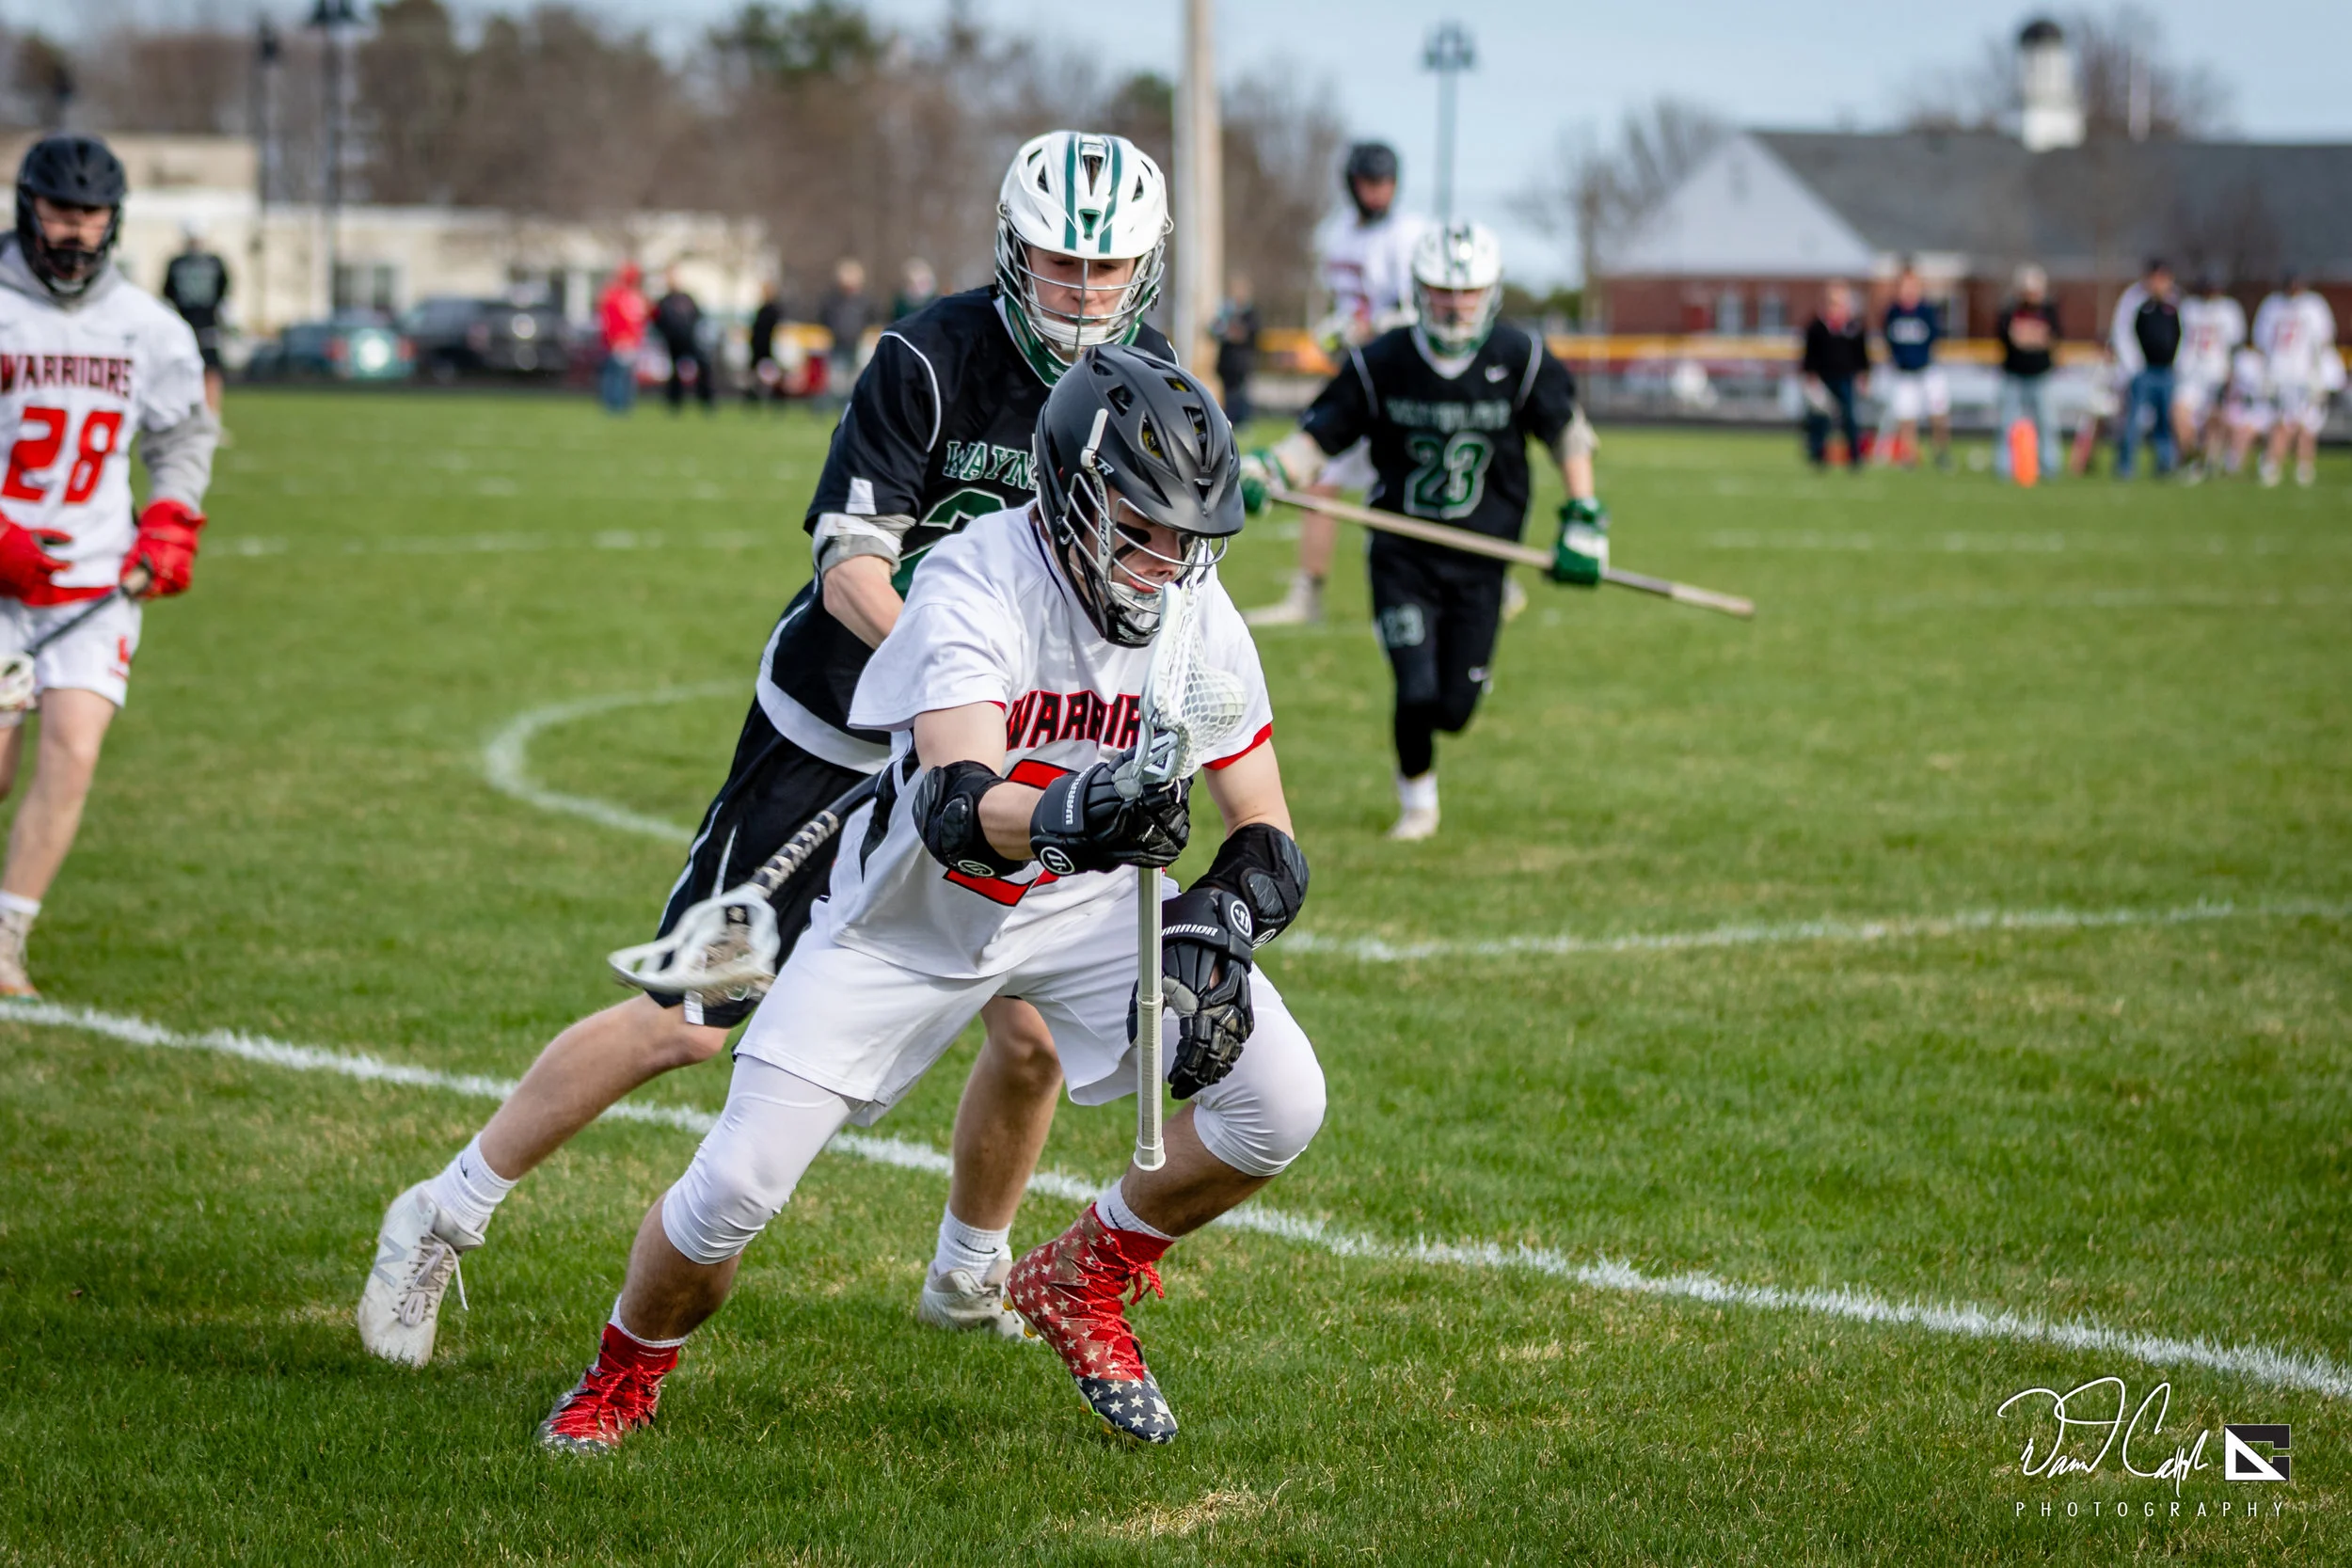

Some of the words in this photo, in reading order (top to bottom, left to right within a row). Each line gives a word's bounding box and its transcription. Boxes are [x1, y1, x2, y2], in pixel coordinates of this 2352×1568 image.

[2, 406, 123, 504] 28
[944, 440, 1037, 490] WAYN
[1404, 431, 1494, 519] 23
[1161, 923, 1218, 937] ARRIOR
